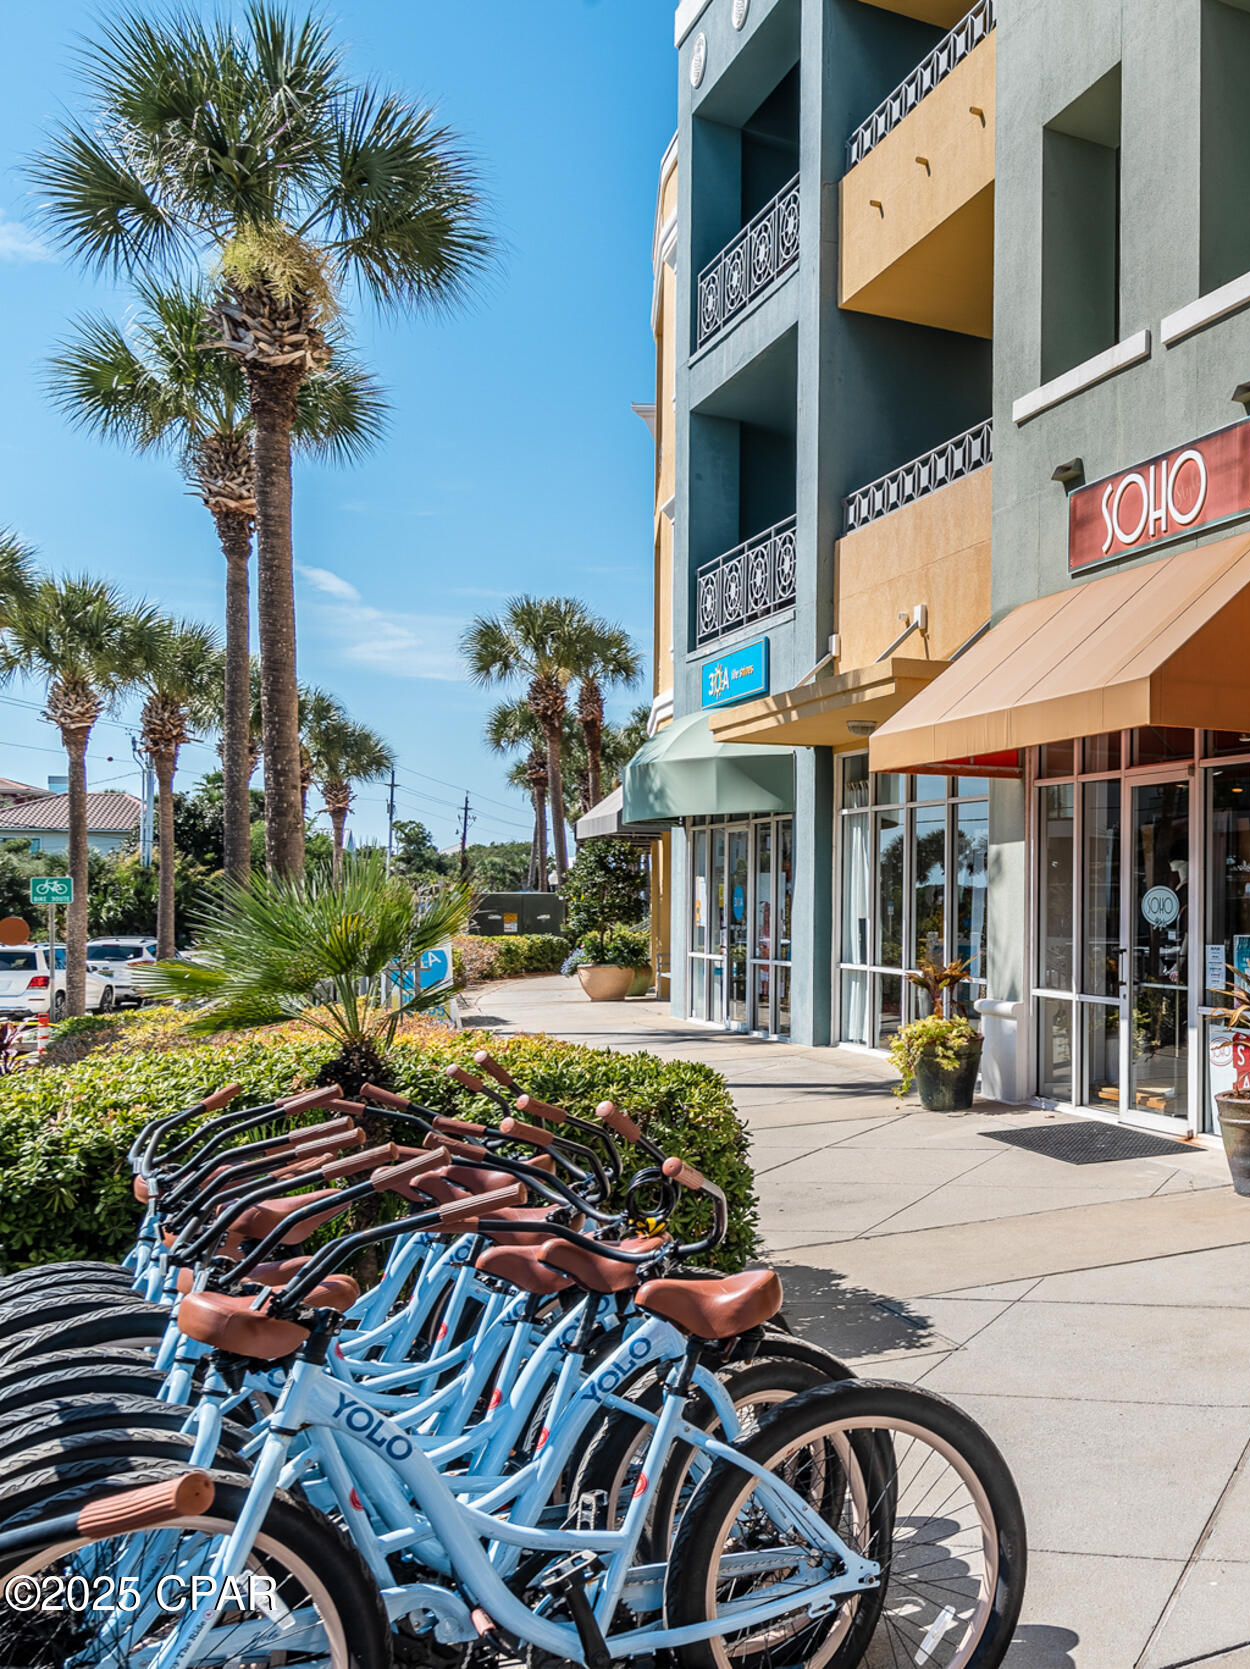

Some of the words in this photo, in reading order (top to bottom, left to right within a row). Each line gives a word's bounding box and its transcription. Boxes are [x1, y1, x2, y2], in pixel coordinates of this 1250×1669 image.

[1101, 450, 1207, 553] SOHO
[1145, 896, 1173, 914] SOHO
[580, 1337, 652, 1403] YOLO
[333, 1391, 413, 1461] YOLO
[176, 1641, 192, 1658] The
[188, 1621, 206, 1641] Ride
